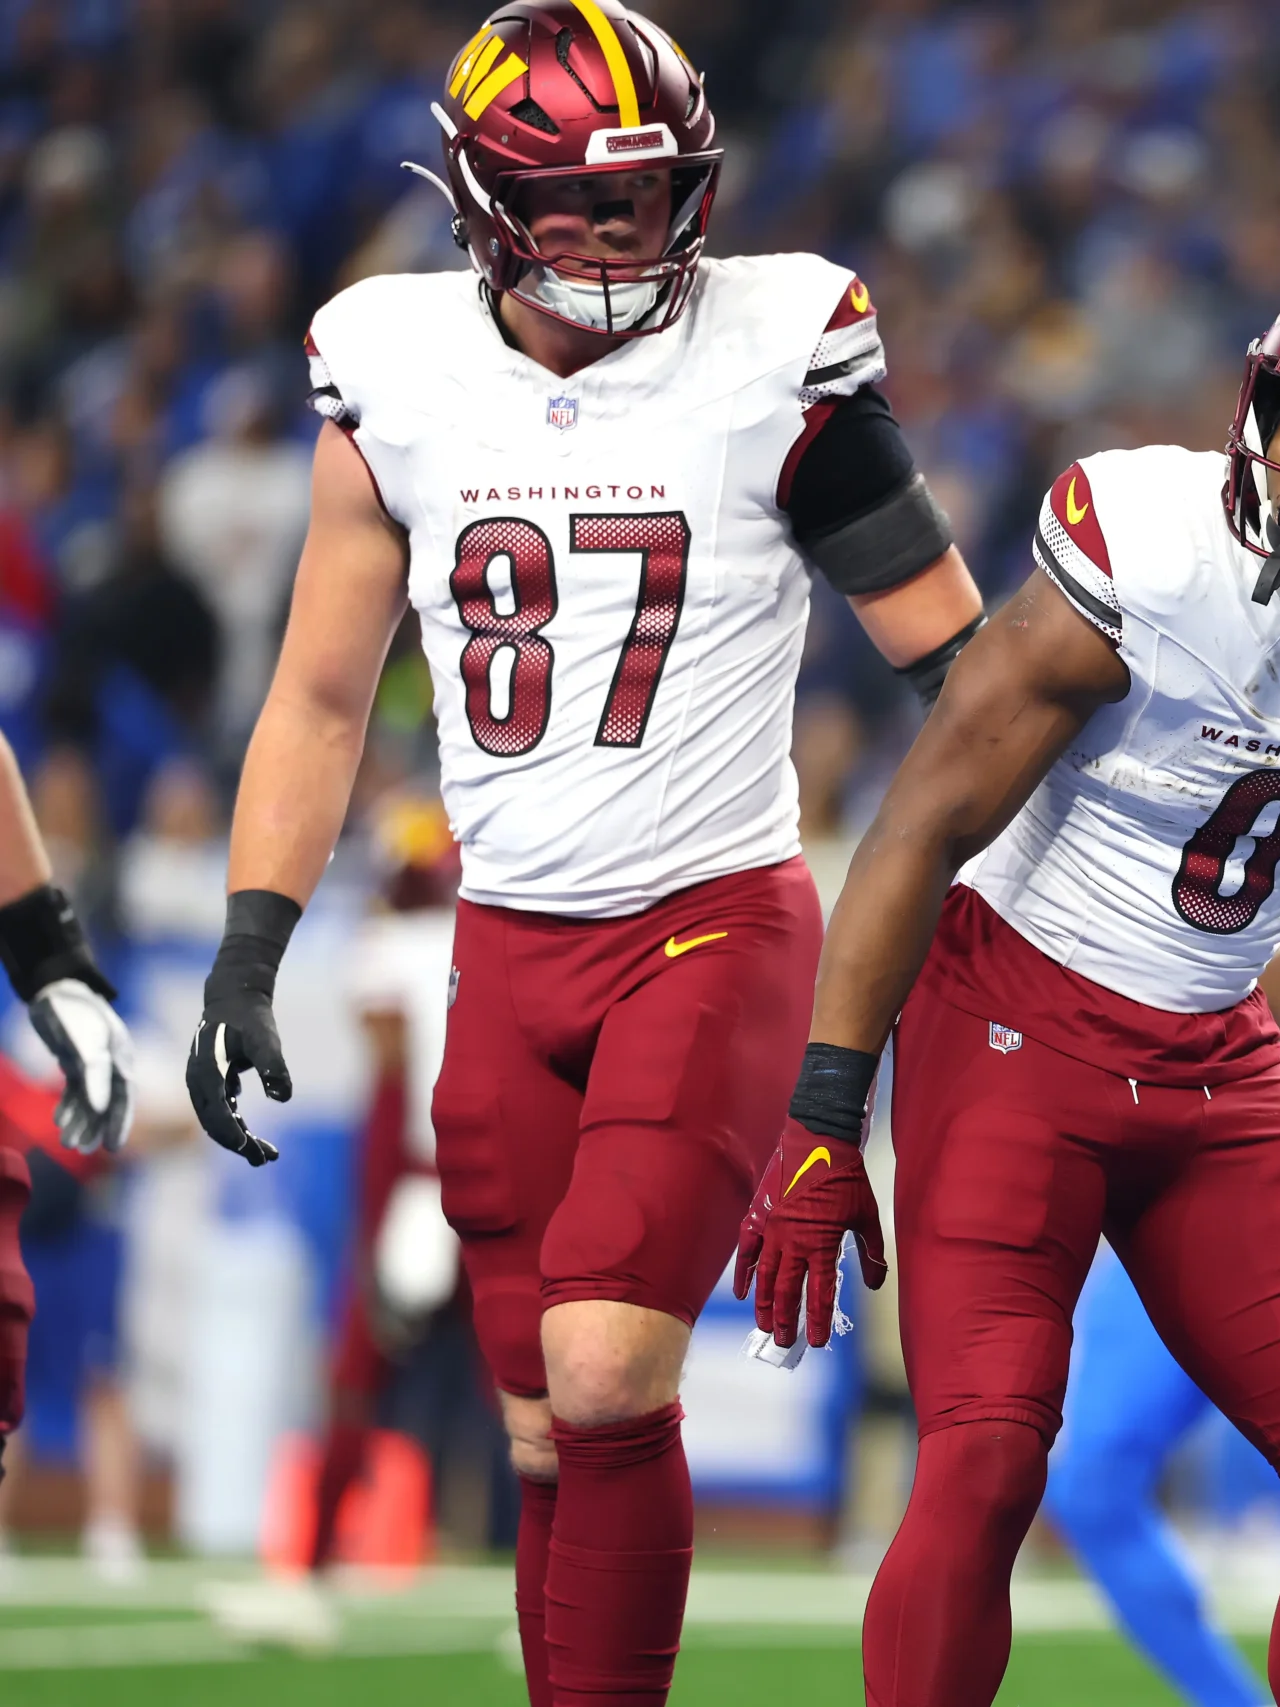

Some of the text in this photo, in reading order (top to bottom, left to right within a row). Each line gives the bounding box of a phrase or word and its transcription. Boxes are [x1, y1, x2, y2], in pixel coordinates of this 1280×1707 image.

[551, 410, 574, 425] NFL
[460, 485, 666, 502] WASHINGTON
[449, 511, 692, 758] 87
[994, 1032, 1018, 1047] NFL
